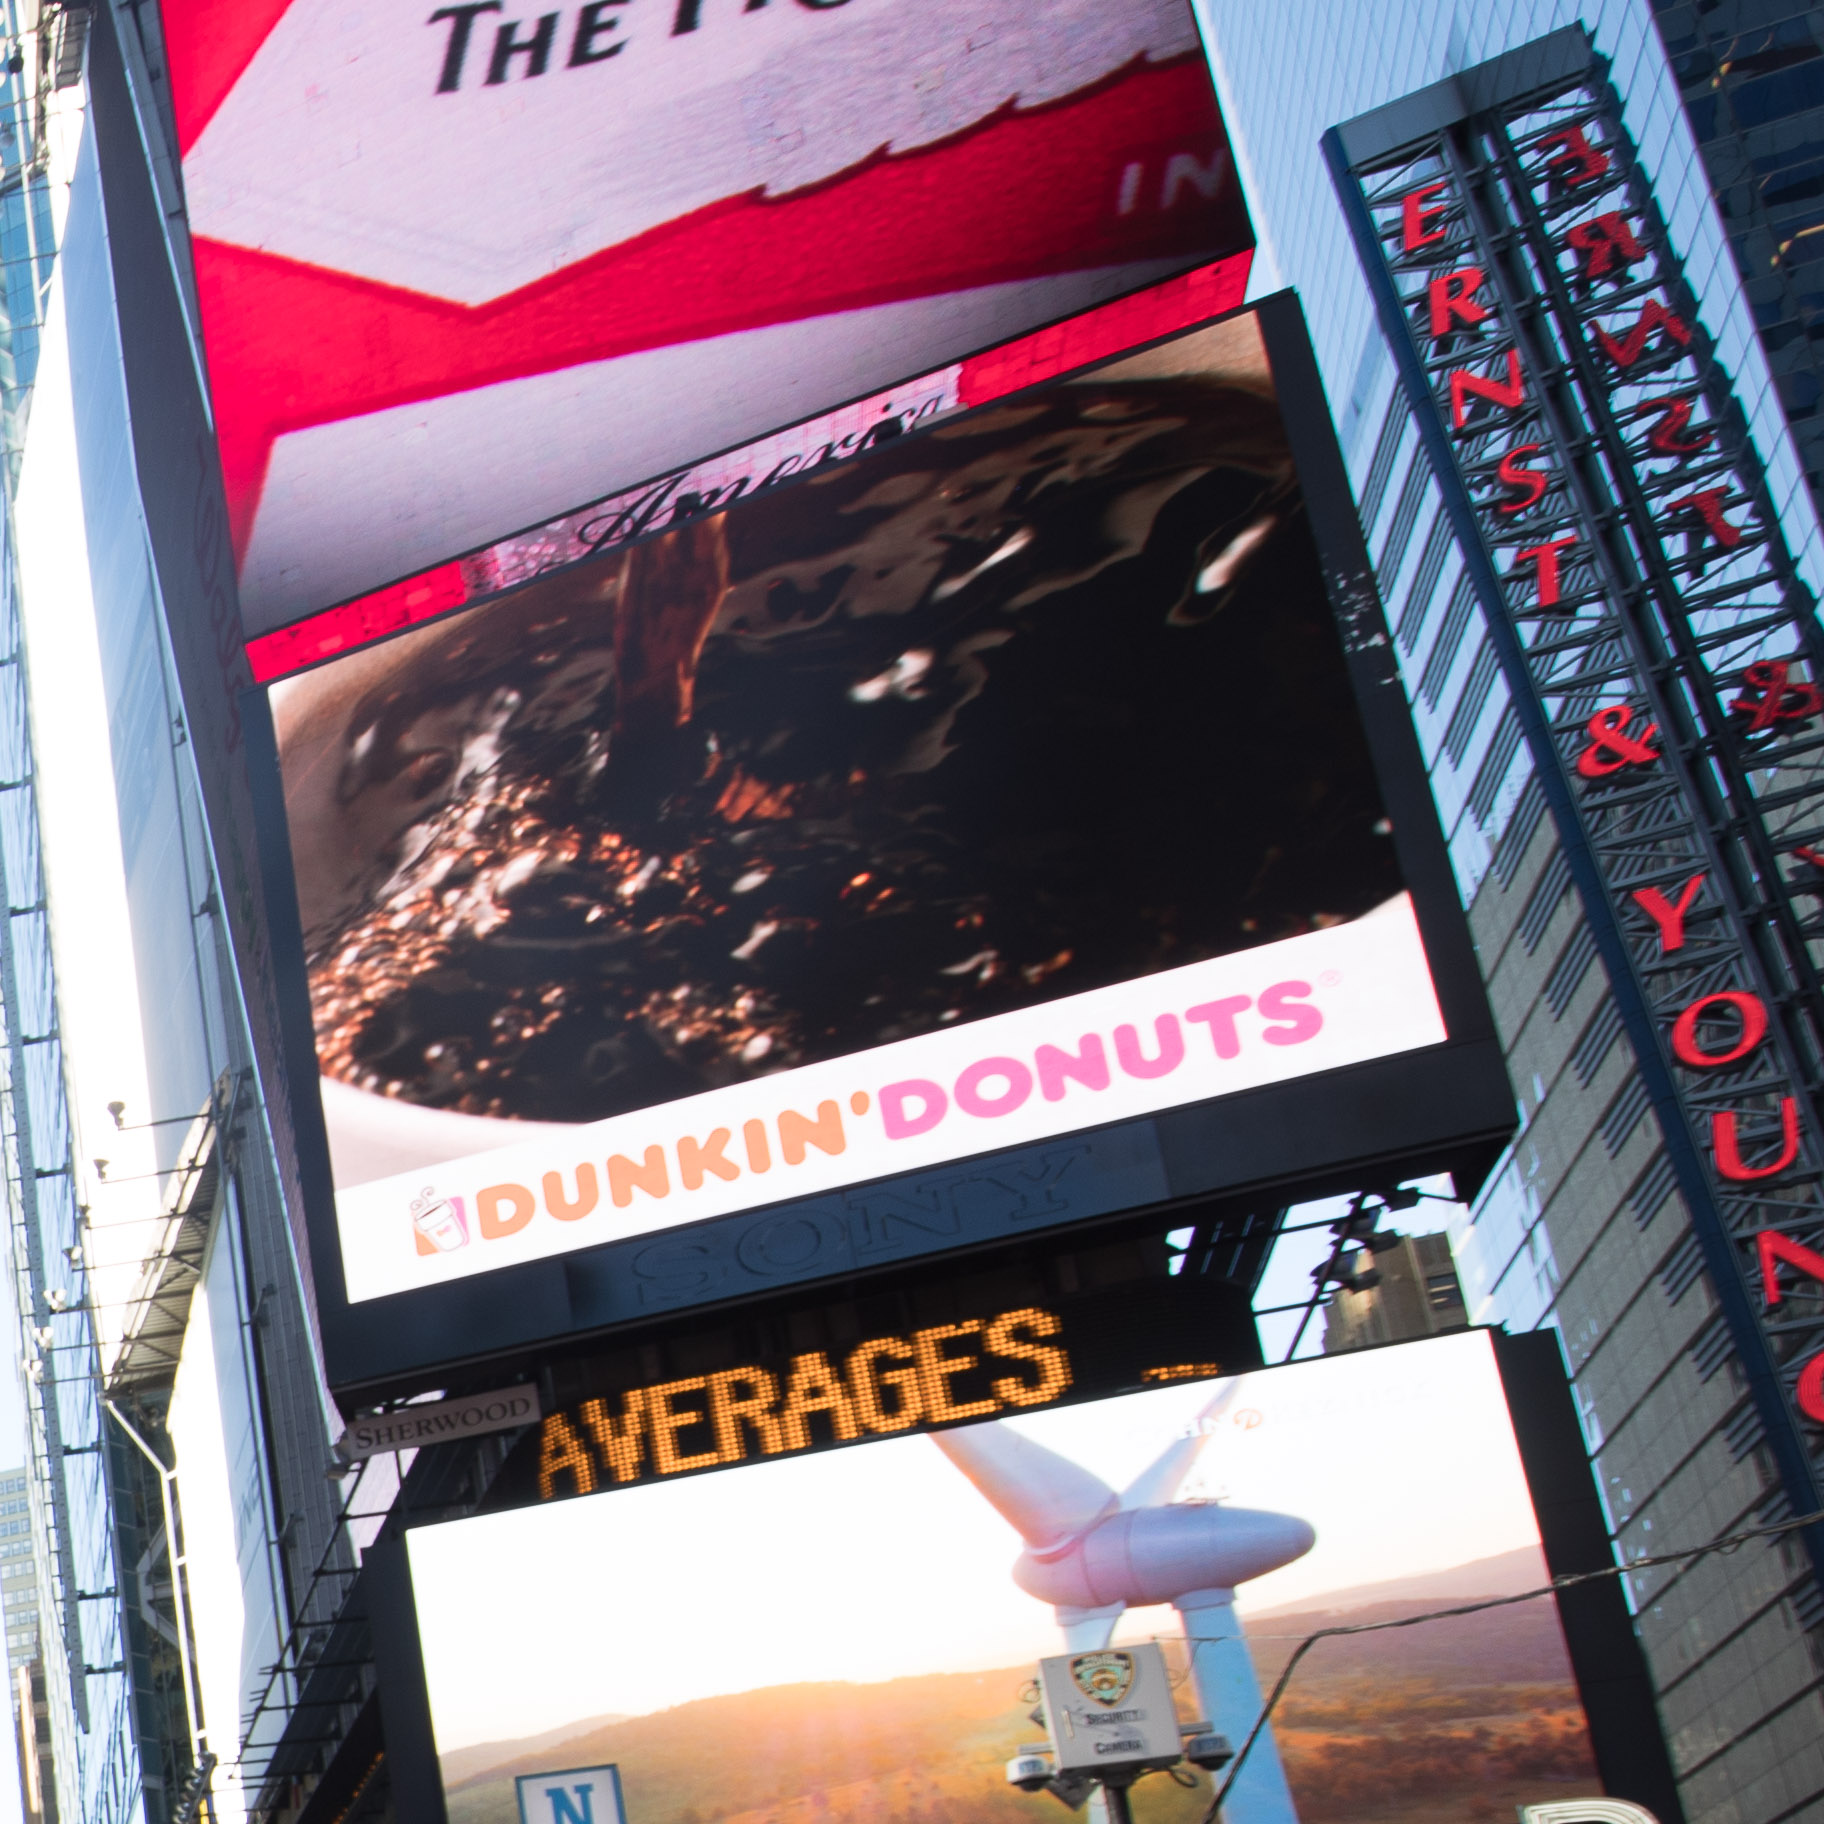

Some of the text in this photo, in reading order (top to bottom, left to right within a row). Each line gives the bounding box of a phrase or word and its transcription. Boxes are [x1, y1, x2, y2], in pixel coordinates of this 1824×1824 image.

[427, 0, 631, 94] THE
[1402, 183, 1577, 607] ERNST
[1578, 705, 1660, 777] &
[878, 979, 1325, 1141] DONUTS
[630, 1145, 1093, 1308] SONY
[354, 1396, 531, 1452] SHERWOOD
[539, 1307, 1074, 1499] AVERAGES
